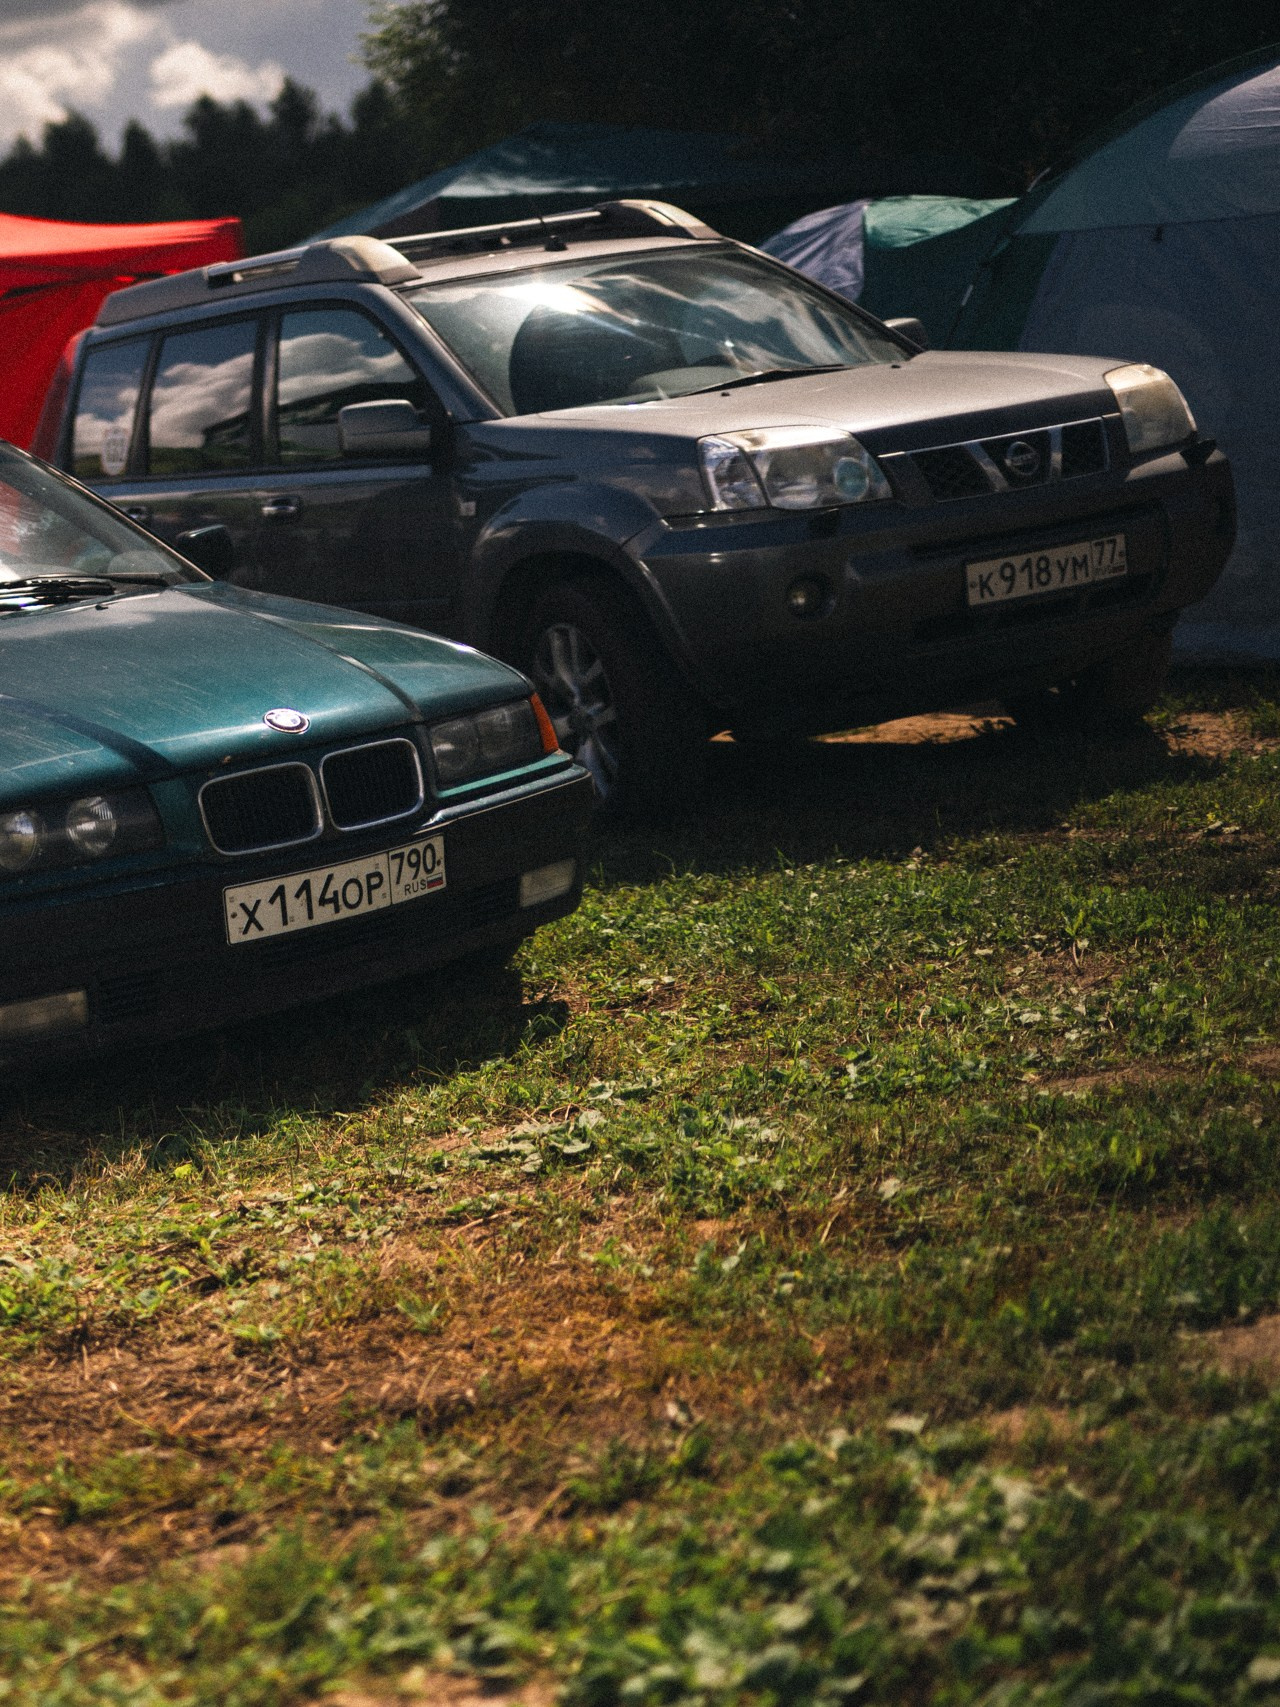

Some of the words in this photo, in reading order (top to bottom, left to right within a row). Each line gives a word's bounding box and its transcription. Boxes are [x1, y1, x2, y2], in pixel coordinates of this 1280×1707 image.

[1093, 538, 1117, 566] 77
[390, 842, 437, 885] 790
[404, 878, 427, 896] RUS
